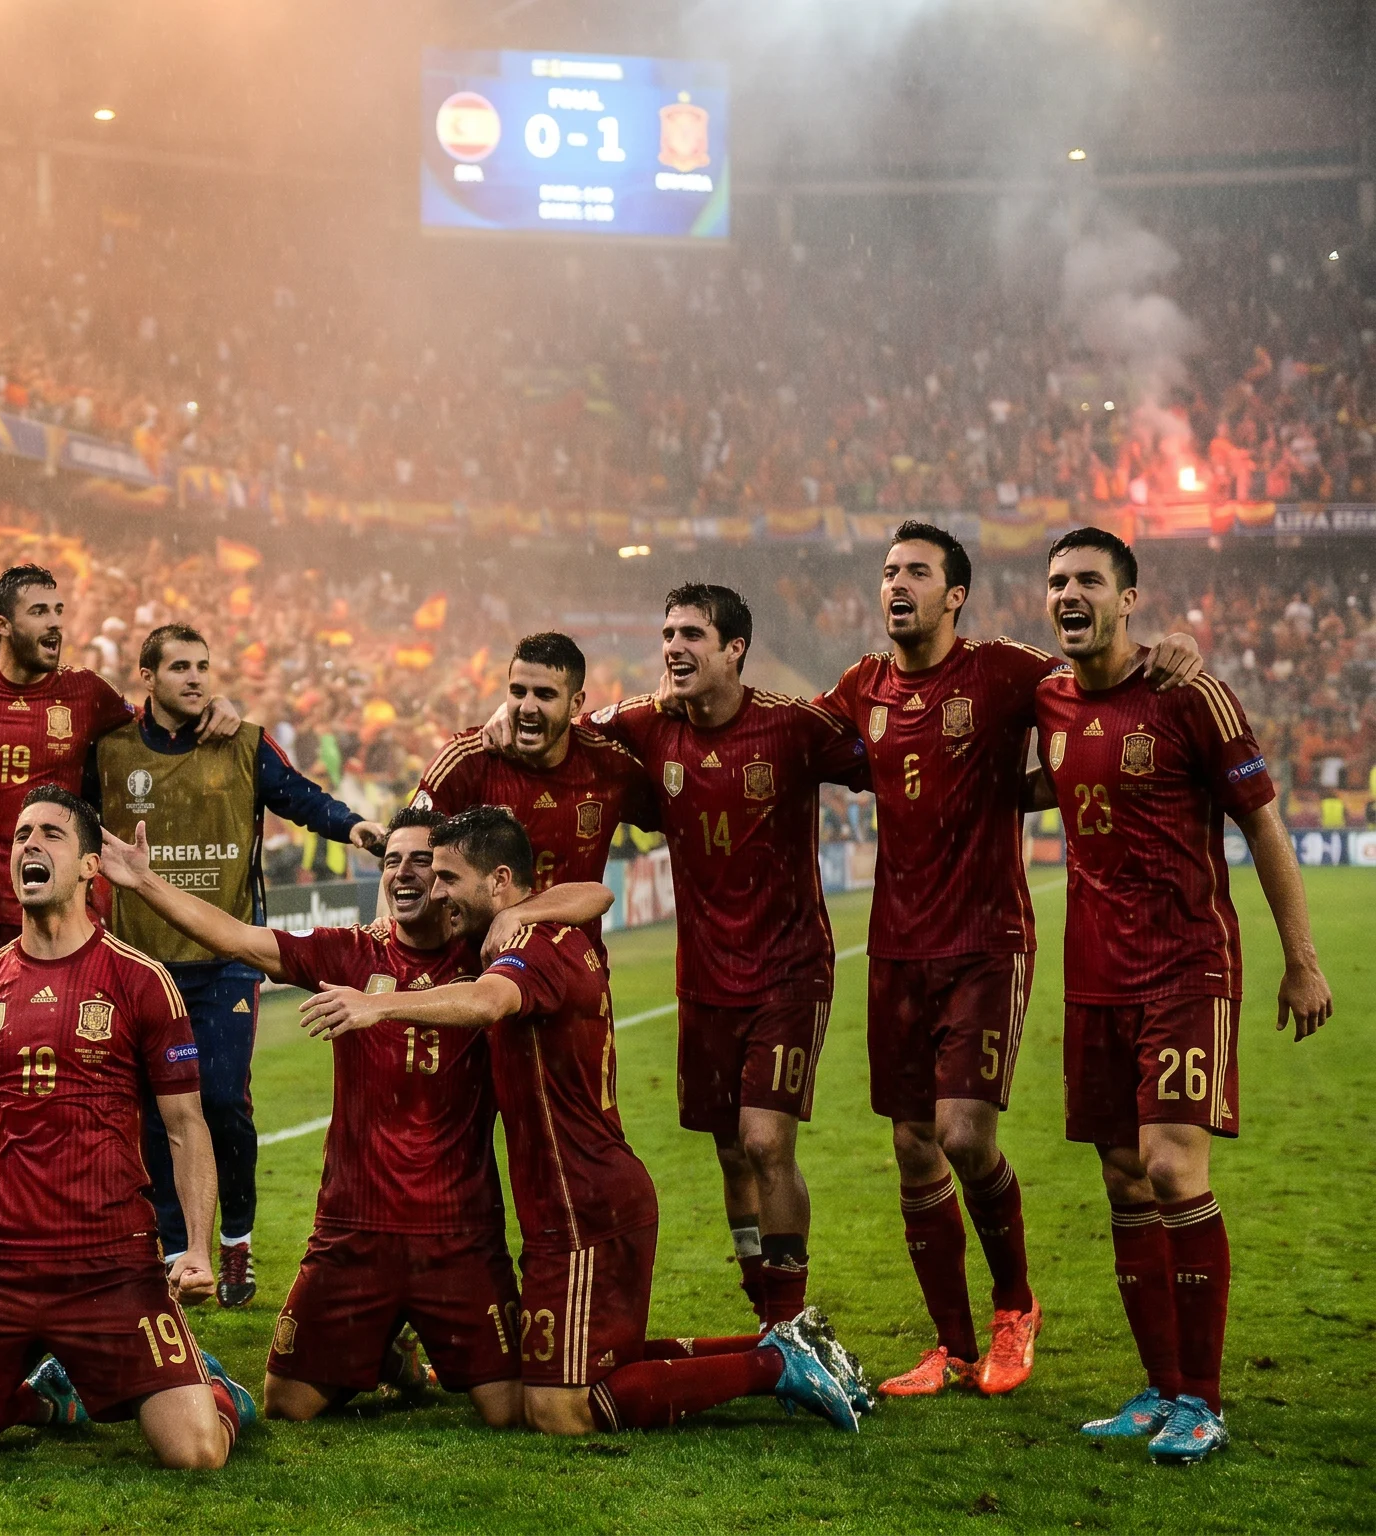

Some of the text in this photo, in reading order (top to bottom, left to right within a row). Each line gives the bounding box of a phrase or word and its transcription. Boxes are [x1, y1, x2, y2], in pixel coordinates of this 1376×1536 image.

[525, 114, 560, 158] 0
[598, 117, 626, 162] 1
[0, 744, 31, 784] 19
[699, 811, 732, 856] 14
[1075, 783, 1113, 835] 23
[17, 1046, 57, 1096] 19
[403, 1026, 440, 1075] 13
[980, 1029, 1001, 1080] 5
[1158, 1047, 1207, 1101] 26
[138, 1313, 187, 1368] 19
[521, 1309, 555, 1361] 23
